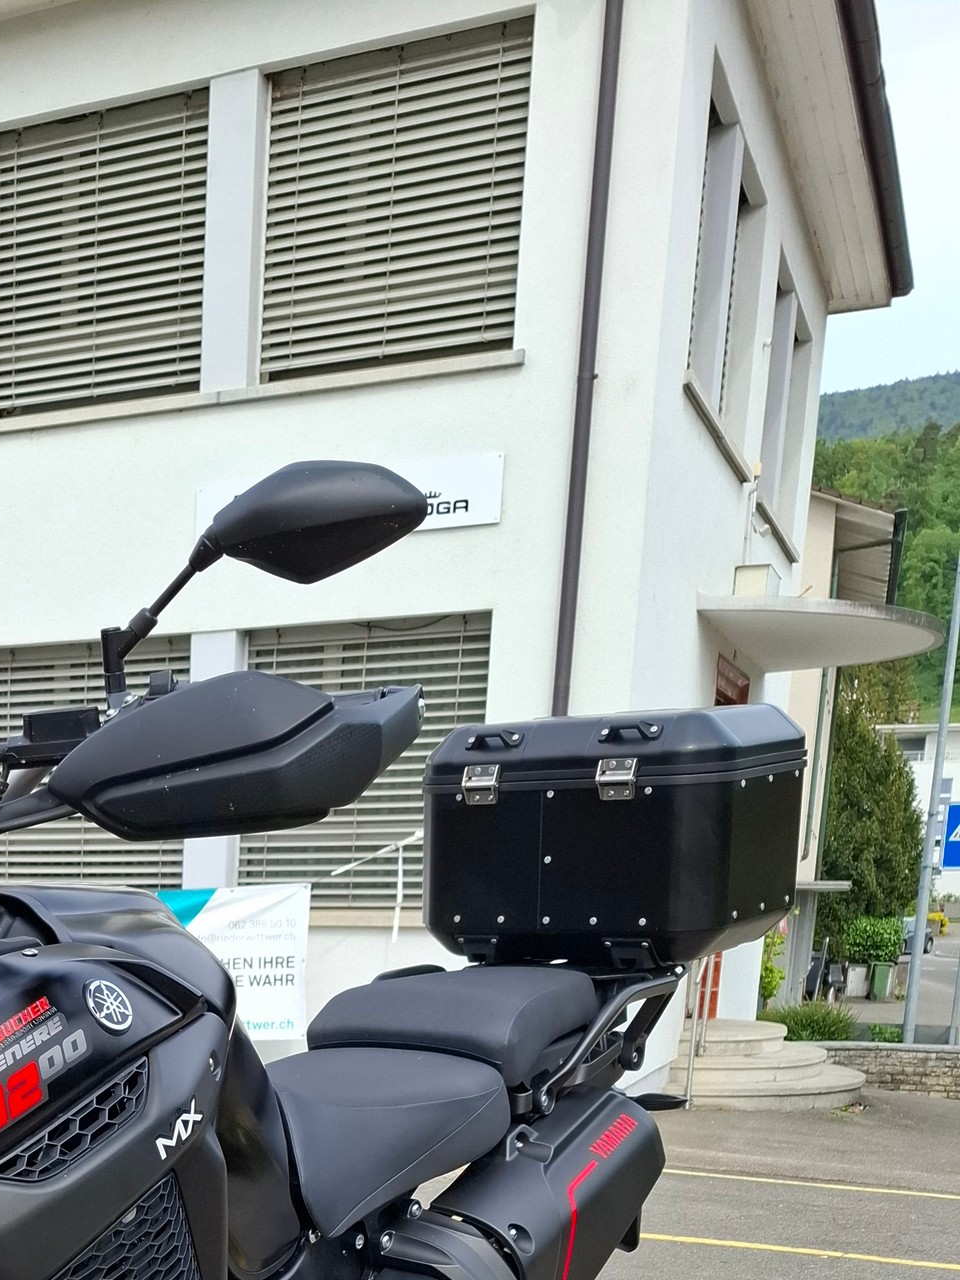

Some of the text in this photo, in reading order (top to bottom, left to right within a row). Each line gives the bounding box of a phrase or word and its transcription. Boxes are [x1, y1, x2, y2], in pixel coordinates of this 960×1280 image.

[258, 955, 296, 969] IHRE
[248, 973, 295, 987] WAHR
[242, 1018, 295, 1031] twer.ch
[155, 1098, 203, 1160] MX
[589, 1113, 638, 1158] YAMAHA
